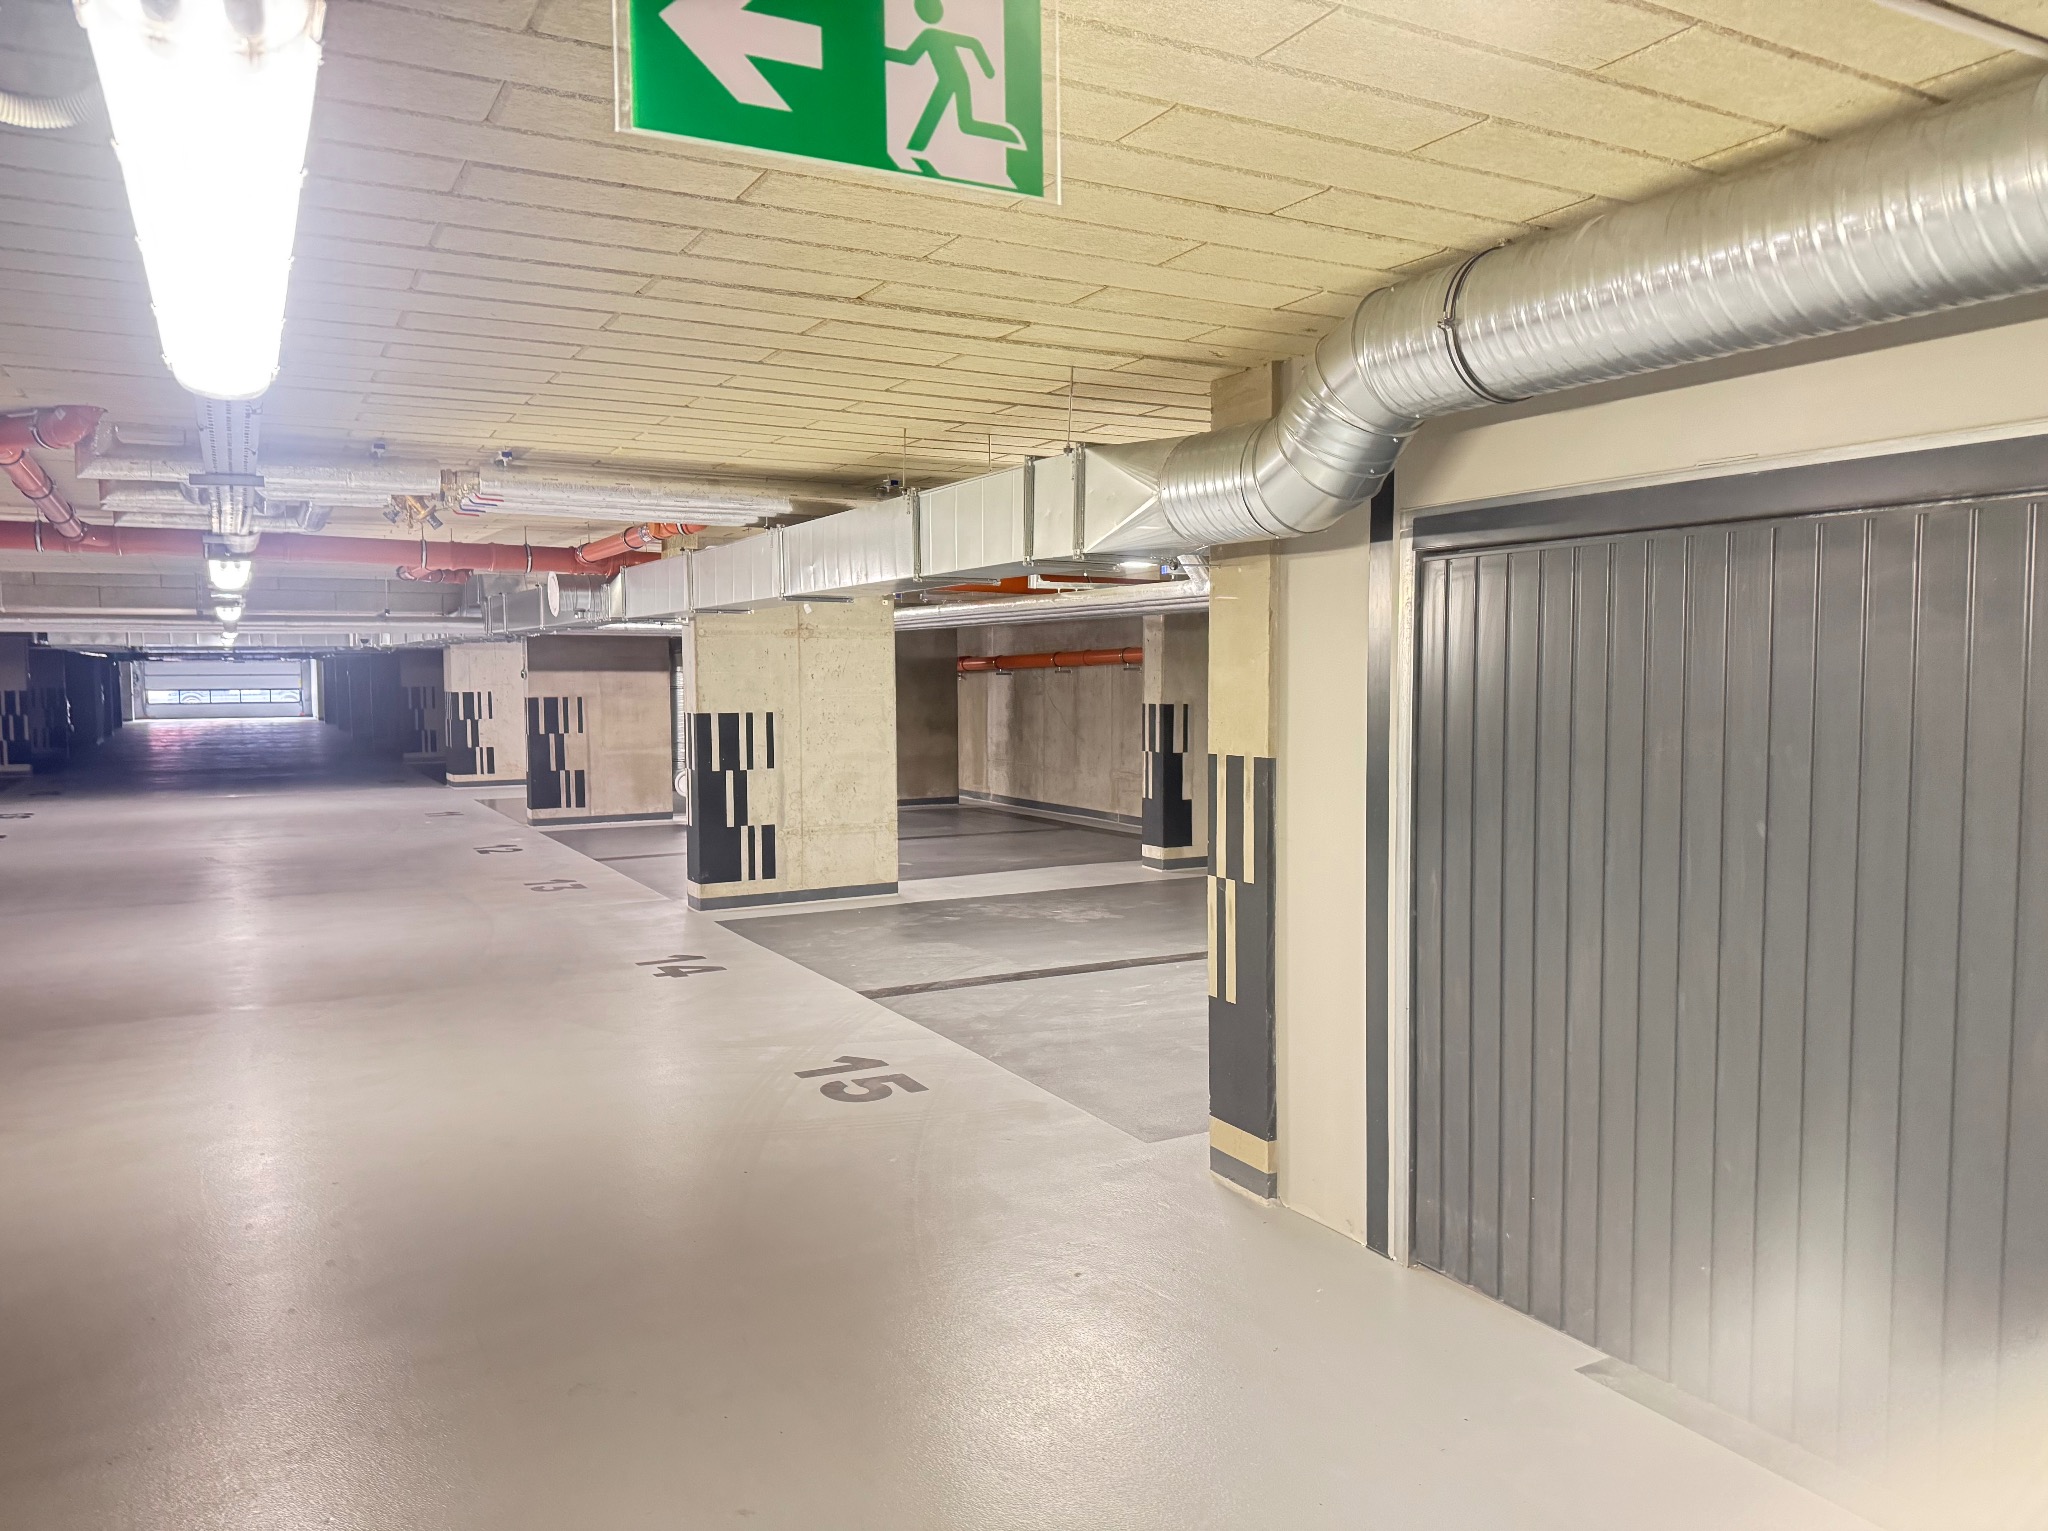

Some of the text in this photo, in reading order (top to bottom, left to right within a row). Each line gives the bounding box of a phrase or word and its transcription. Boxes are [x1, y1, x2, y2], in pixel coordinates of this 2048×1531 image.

[473, 844, 524, 855] 12
[523, 879, 588, 892] 13
[635, 954, 727, 978] 14
[794, 1055, 930, 1103] 15
